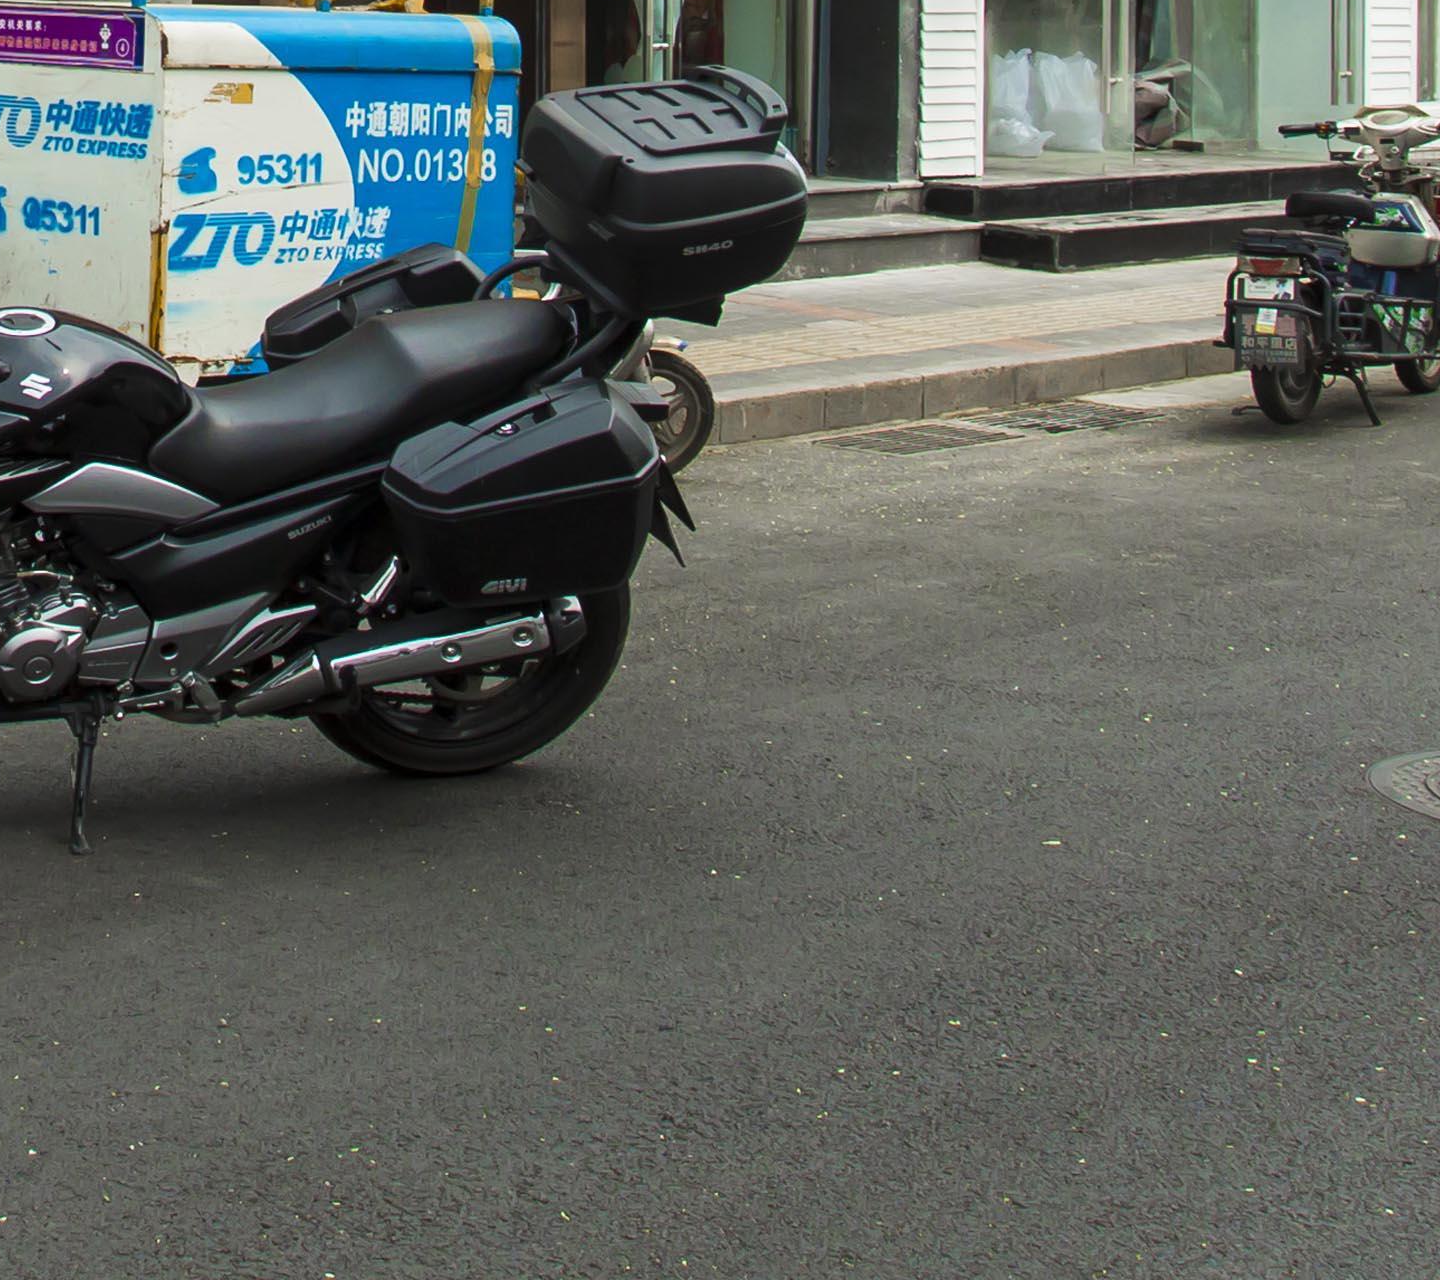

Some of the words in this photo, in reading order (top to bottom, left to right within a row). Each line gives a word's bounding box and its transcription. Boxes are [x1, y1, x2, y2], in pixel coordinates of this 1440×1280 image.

[44, 96, 154, 141] 中通快递
[42, 136, 73, 153] ZTO
[76, 139, 149, 160] EXPRESS
[357, 148, 498, 184] NO.0138
[237, 151, 323, 185] 95311
[22, 196, 100, 236] 95311
[279, 204, 391, 243] 中通快递
[168, 210, 277, 272] ZTO
[275, 245, 309, 264] ZTO
[312, 241, 385, 261] EXPRESS
[287, 514, 333, 540] SUZUKI
